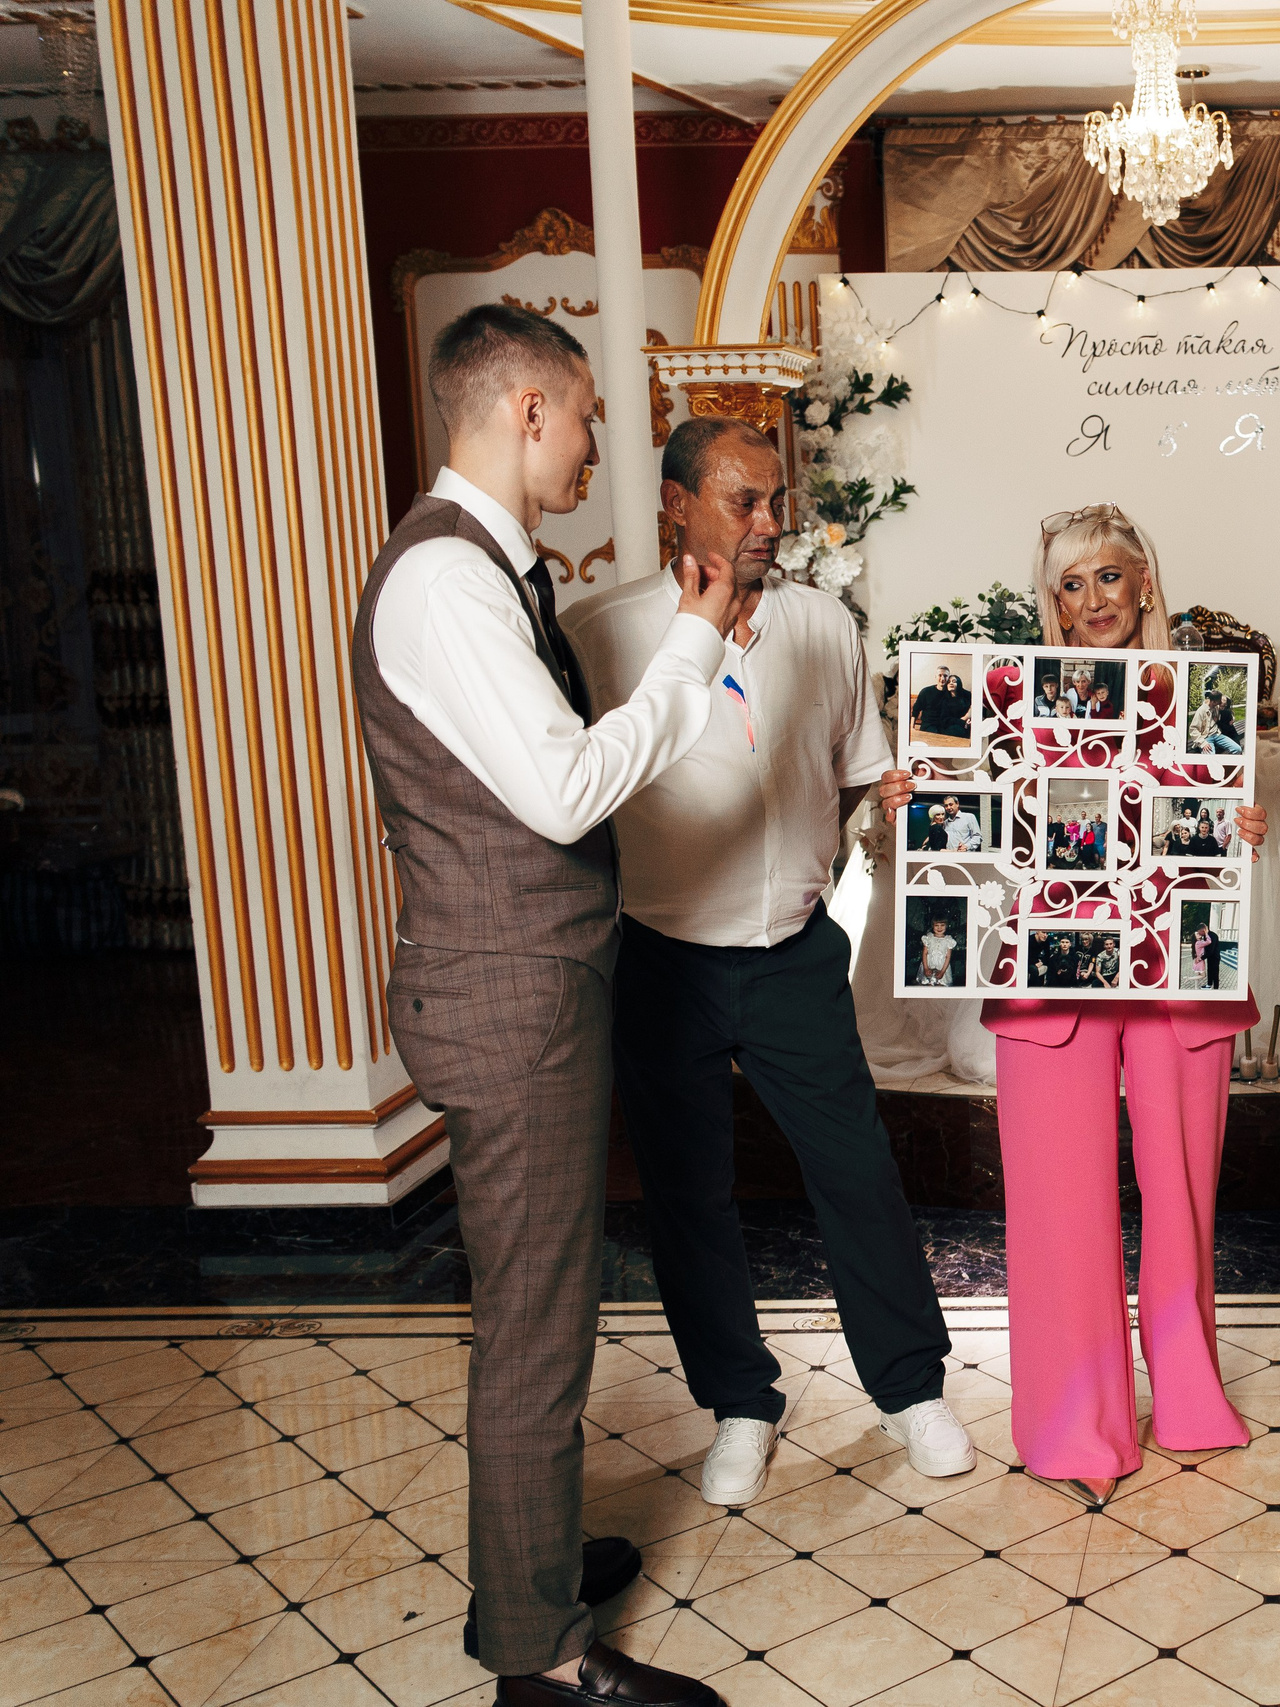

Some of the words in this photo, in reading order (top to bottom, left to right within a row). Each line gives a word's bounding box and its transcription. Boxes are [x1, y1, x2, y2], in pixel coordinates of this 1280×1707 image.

[1040, 322, 1168, 373] Просто
[1175, 320, 1274, 356] такая
[1087, 375, 1206, 397] сильная
[1066, 414, 1112, 458] Я
[1219, 412, 1266, 457] Я
